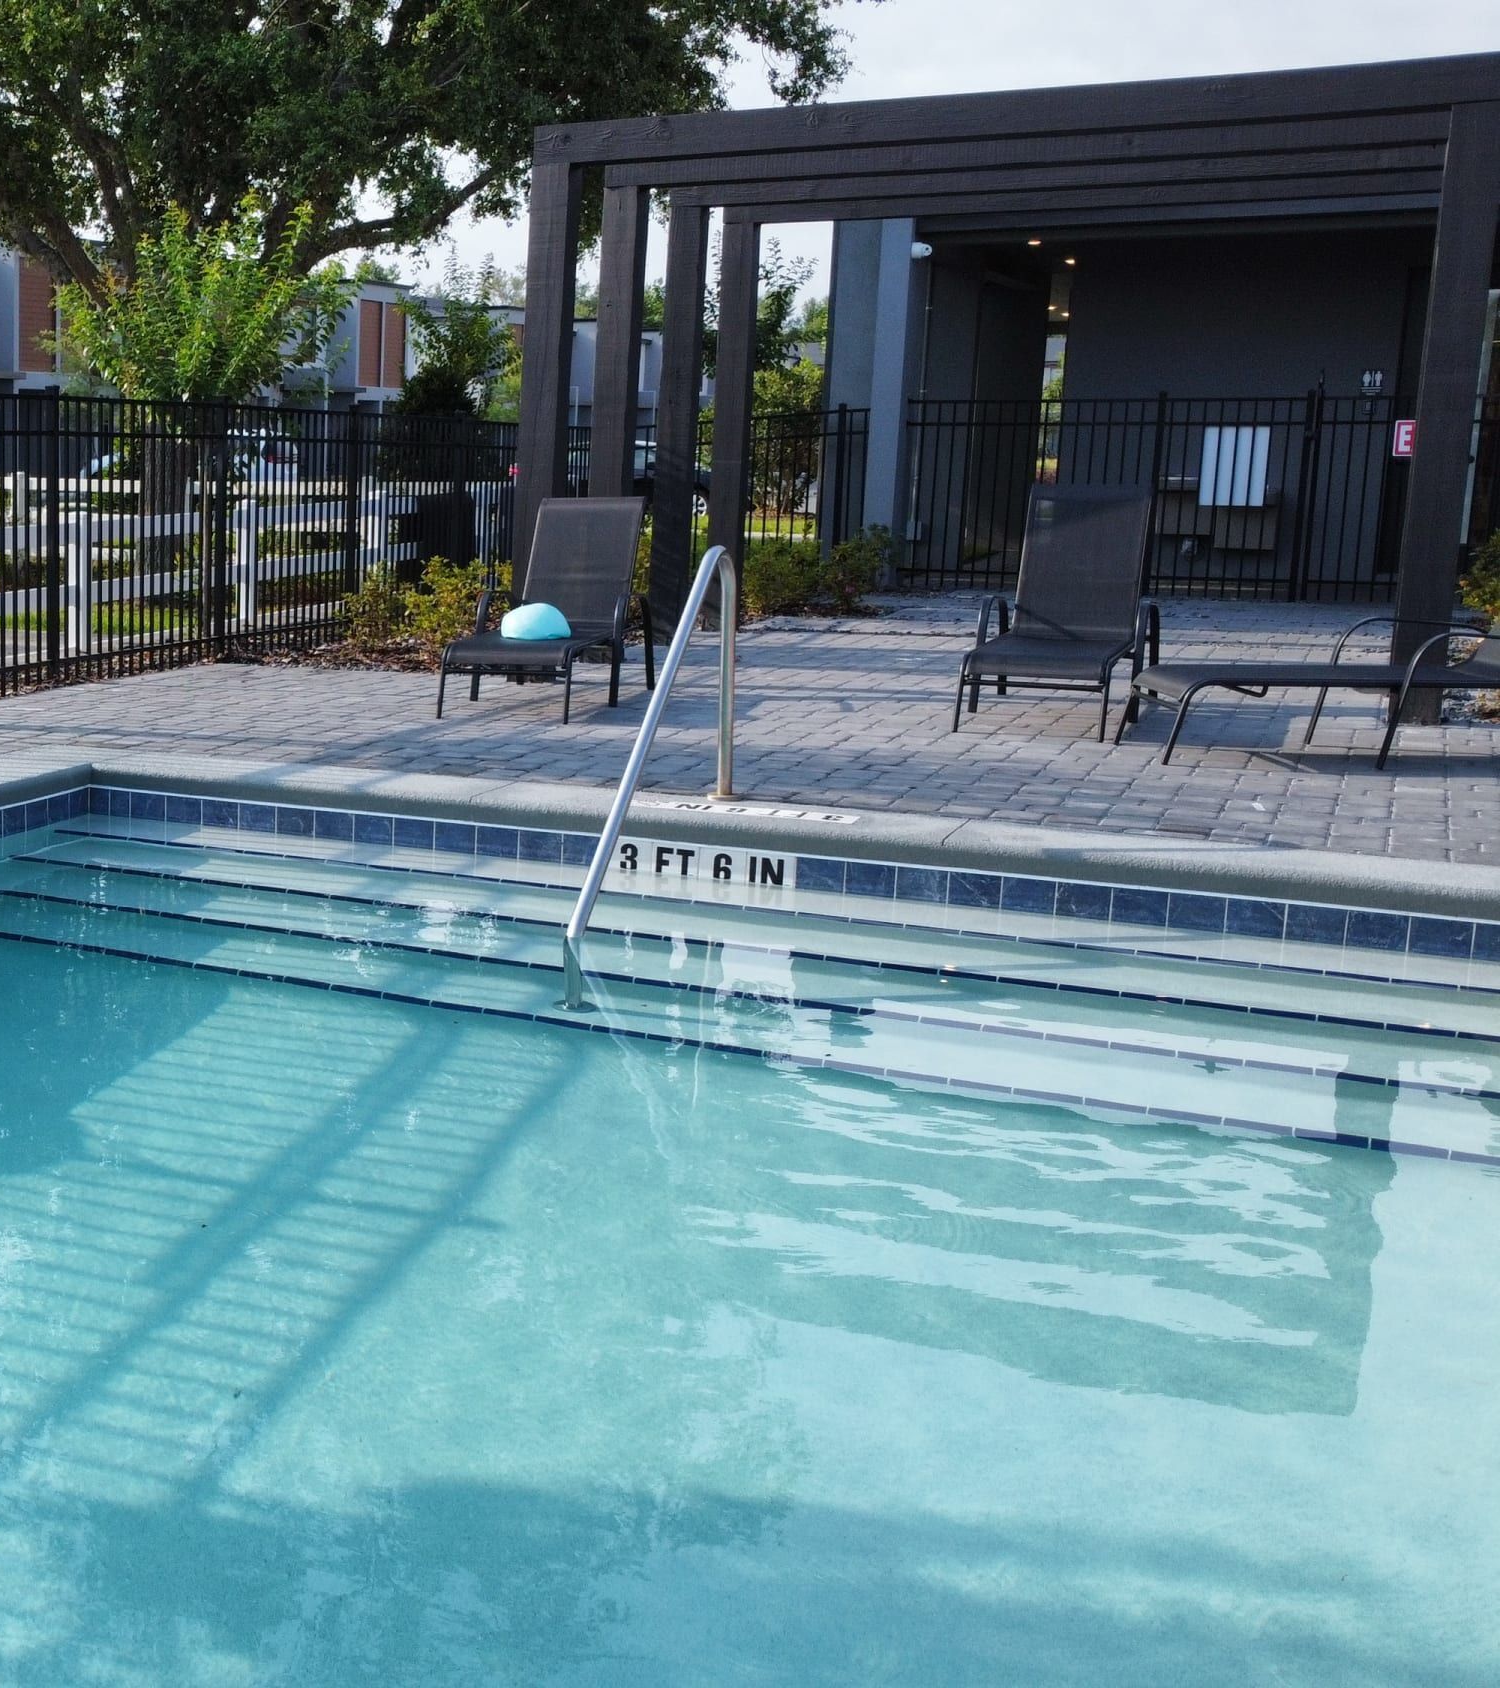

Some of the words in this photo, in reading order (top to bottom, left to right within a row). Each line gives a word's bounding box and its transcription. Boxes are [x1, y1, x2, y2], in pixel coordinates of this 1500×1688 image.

[674, 803, 712, 811] IN
[761, 807, 808, 818] FT
[619, 843, 639, 870] 3
[655, 846, 695, 876] FT
[712, 853, 733, 880] 6
[749, 855, 785, 886] IN
